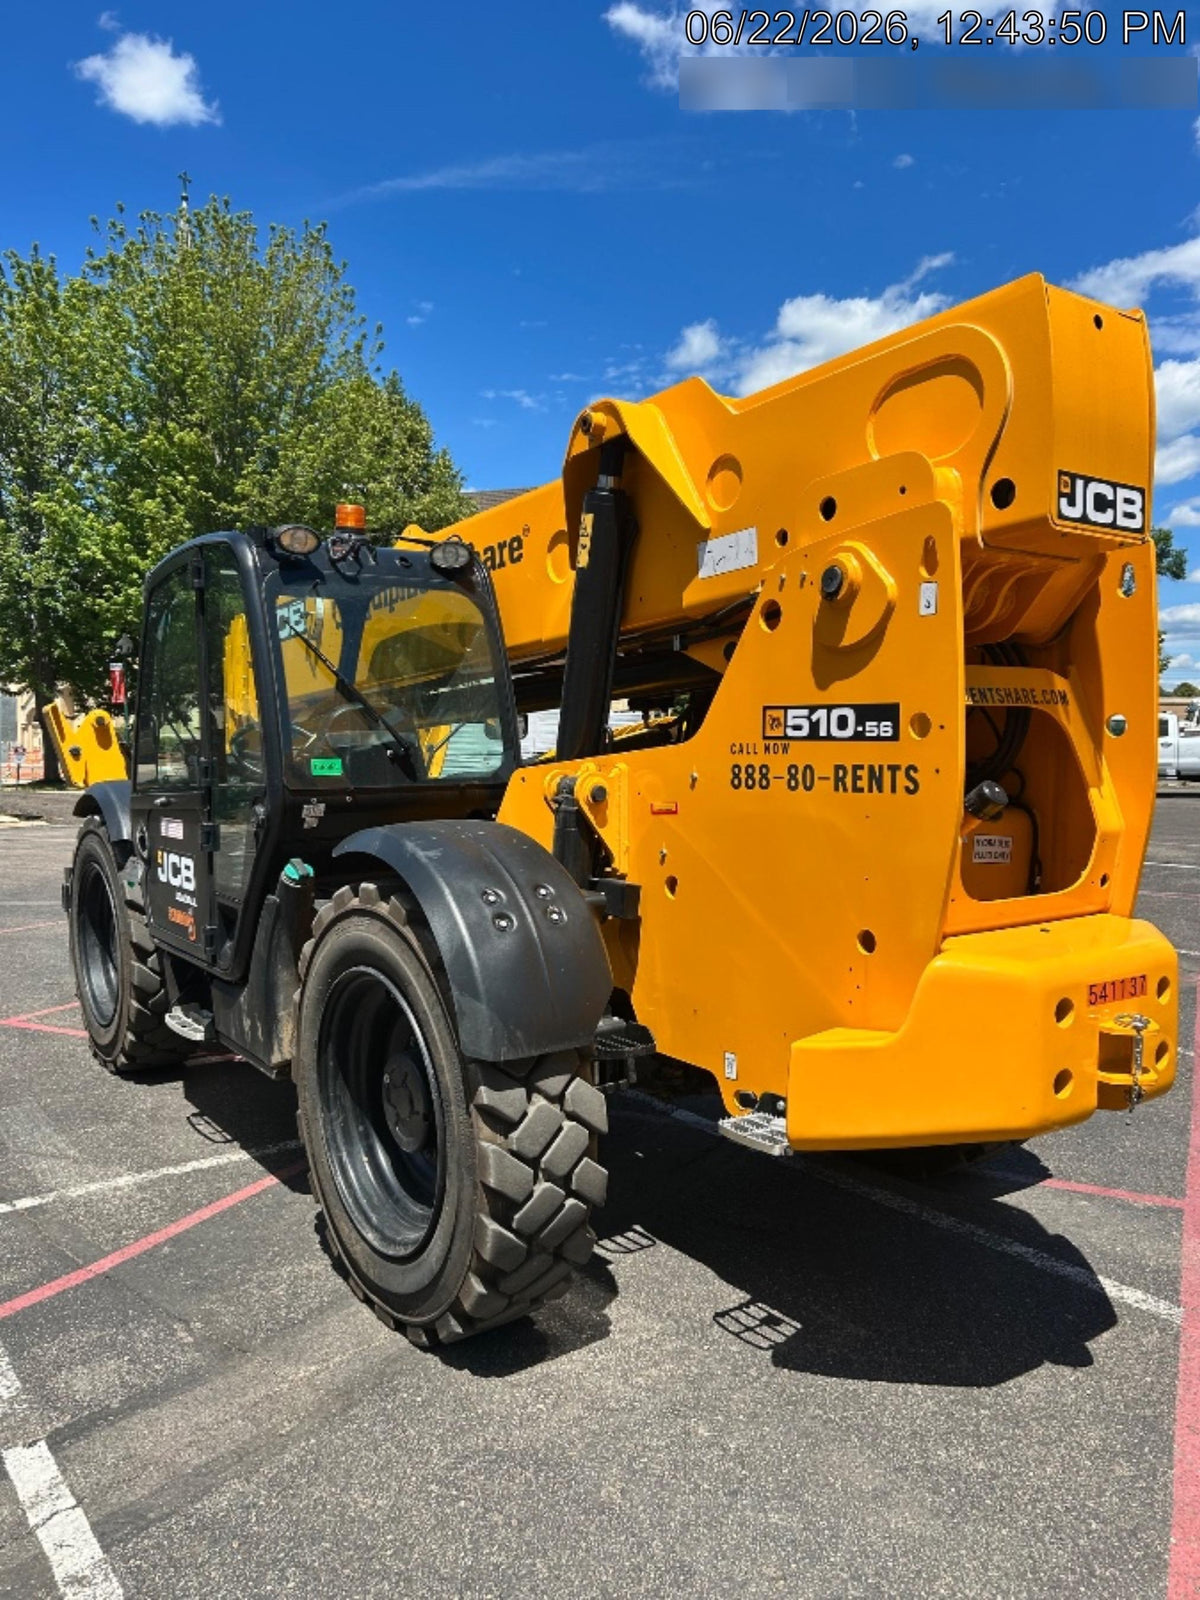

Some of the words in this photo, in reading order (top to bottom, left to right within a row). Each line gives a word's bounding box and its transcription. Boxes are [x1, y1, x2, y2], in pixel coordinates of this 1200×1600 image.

[1059, 478, 1143, 528] JCB
[965, 687, 1070, 706] ENTSHARE.COM
[730, 743, 758, 755] CALL
[764, 742, 790, 755] NOW
[730, 763, 920, 795] 888-80-RENTS
[157, 850, 196, 892] JCB
[1088, 974, 1147, 1006] 541137
